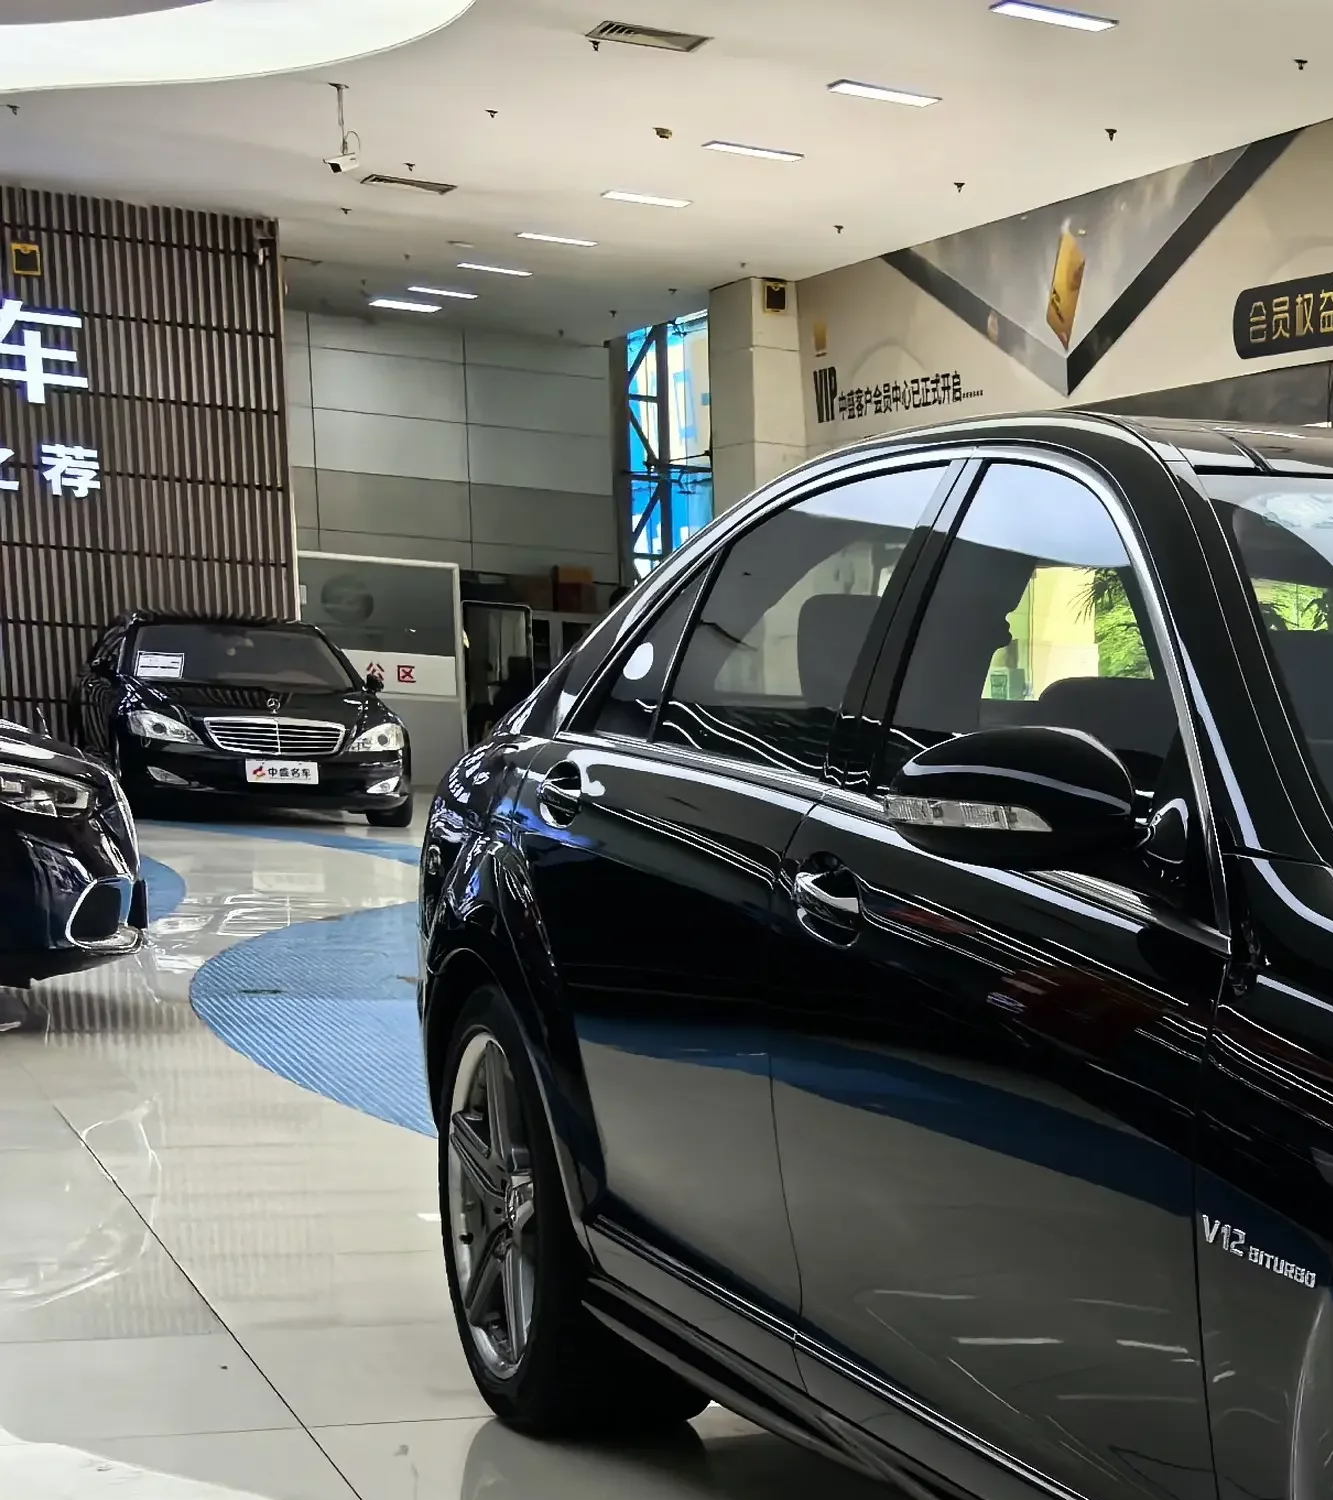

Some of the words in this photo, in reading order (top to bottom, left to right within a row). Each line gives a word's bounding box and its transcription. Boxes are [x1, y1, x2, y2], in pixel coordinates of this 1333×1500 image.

[0, 298, 89, 404] 车
[812, 366, 838, 423] VIP
[1202, 1214, 1247, 1257] V12
[1248, 1245, 1317, 1288] BITURBO
